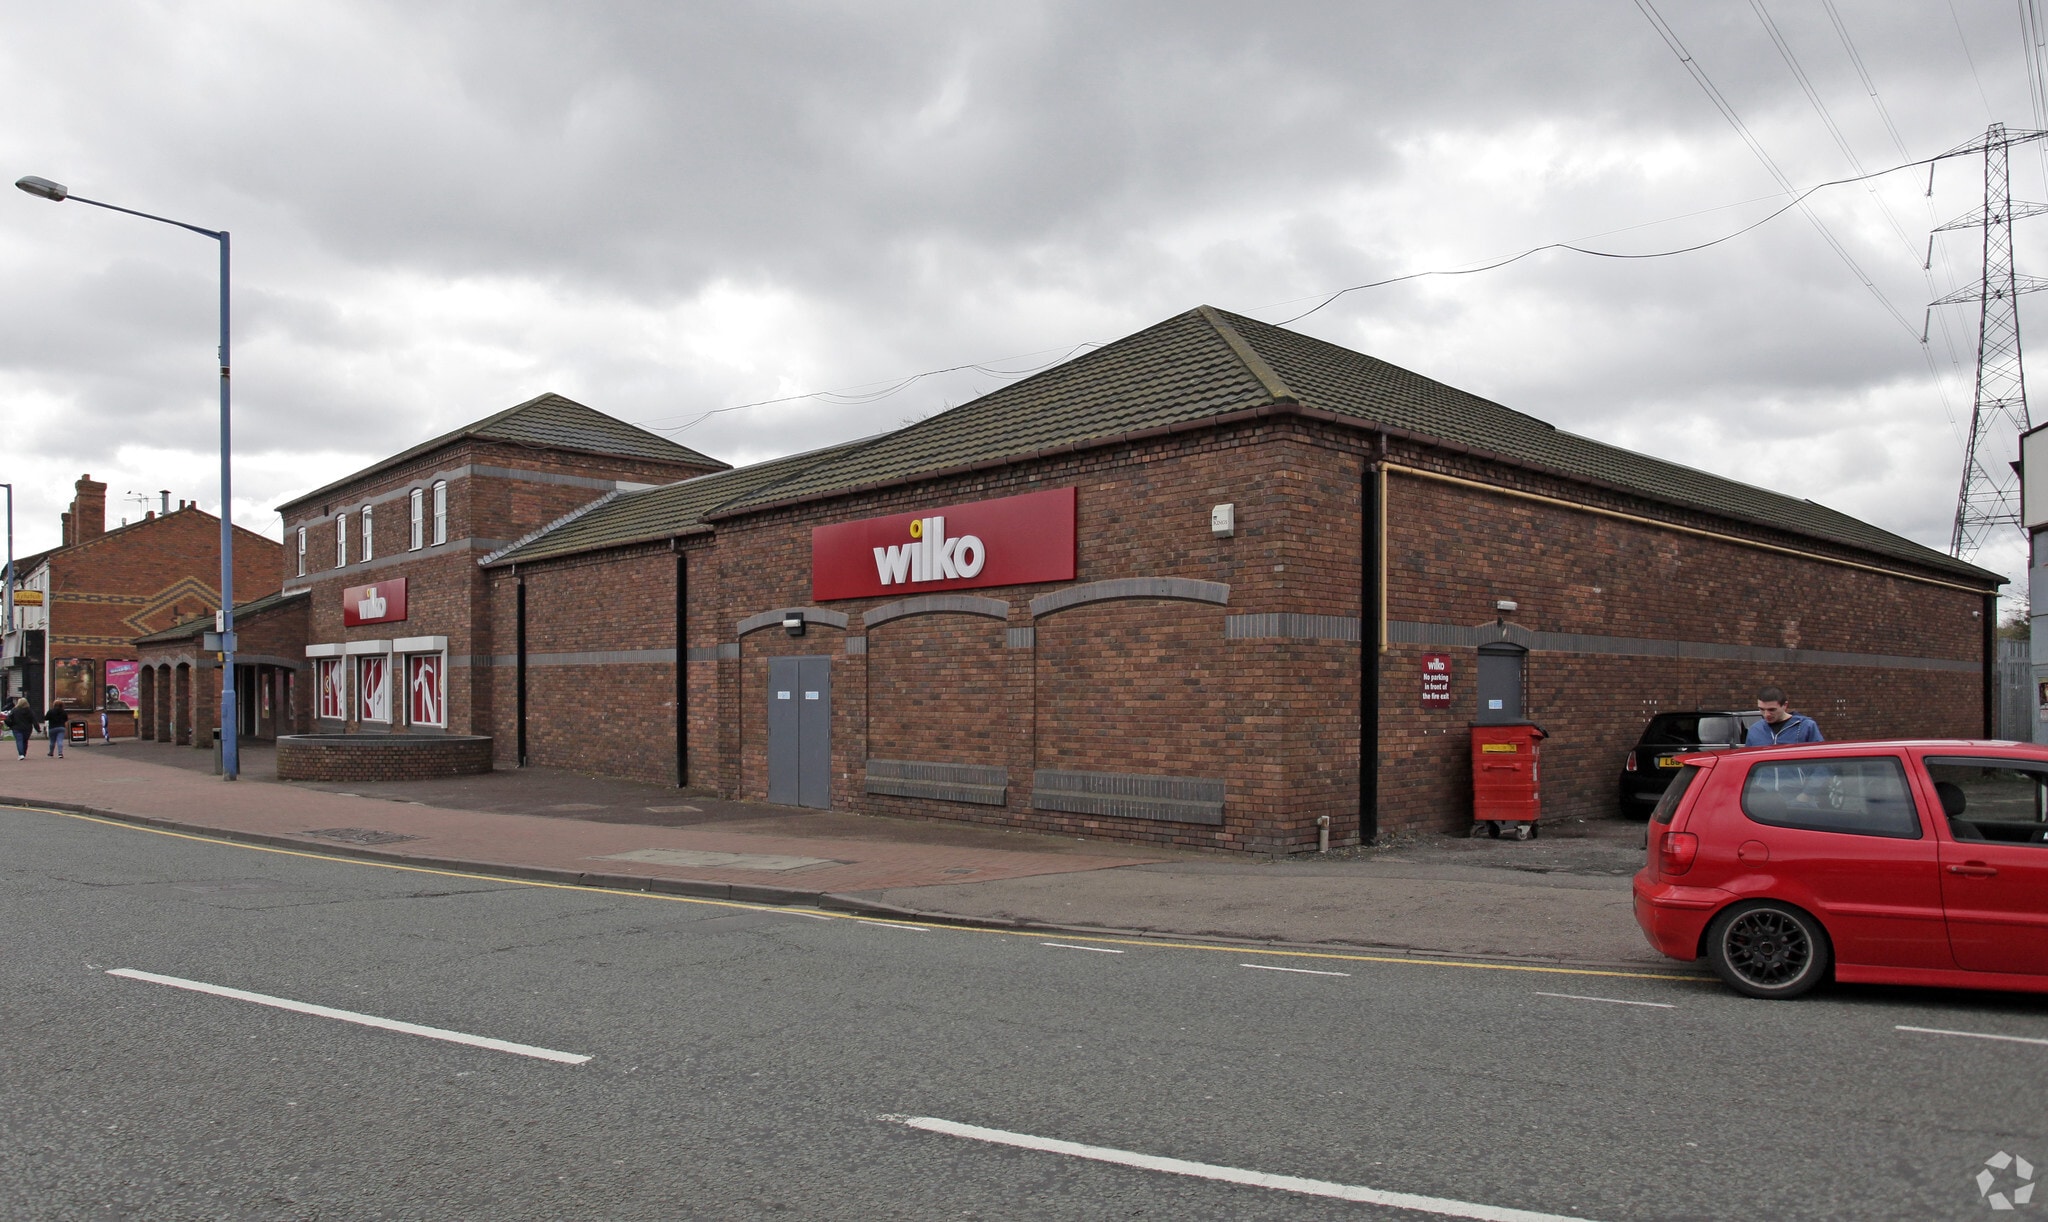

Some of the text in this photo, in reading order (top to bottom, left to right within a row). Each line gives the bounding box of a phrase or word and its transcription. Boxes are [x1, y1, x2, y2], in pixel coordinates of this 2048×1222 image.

[873, 516, 985, 585] wilko
[358, 587, 386, 619] wilko
[1428, 658, 1445, 670] wilko
[1431, 673, 1448, 682] parking
